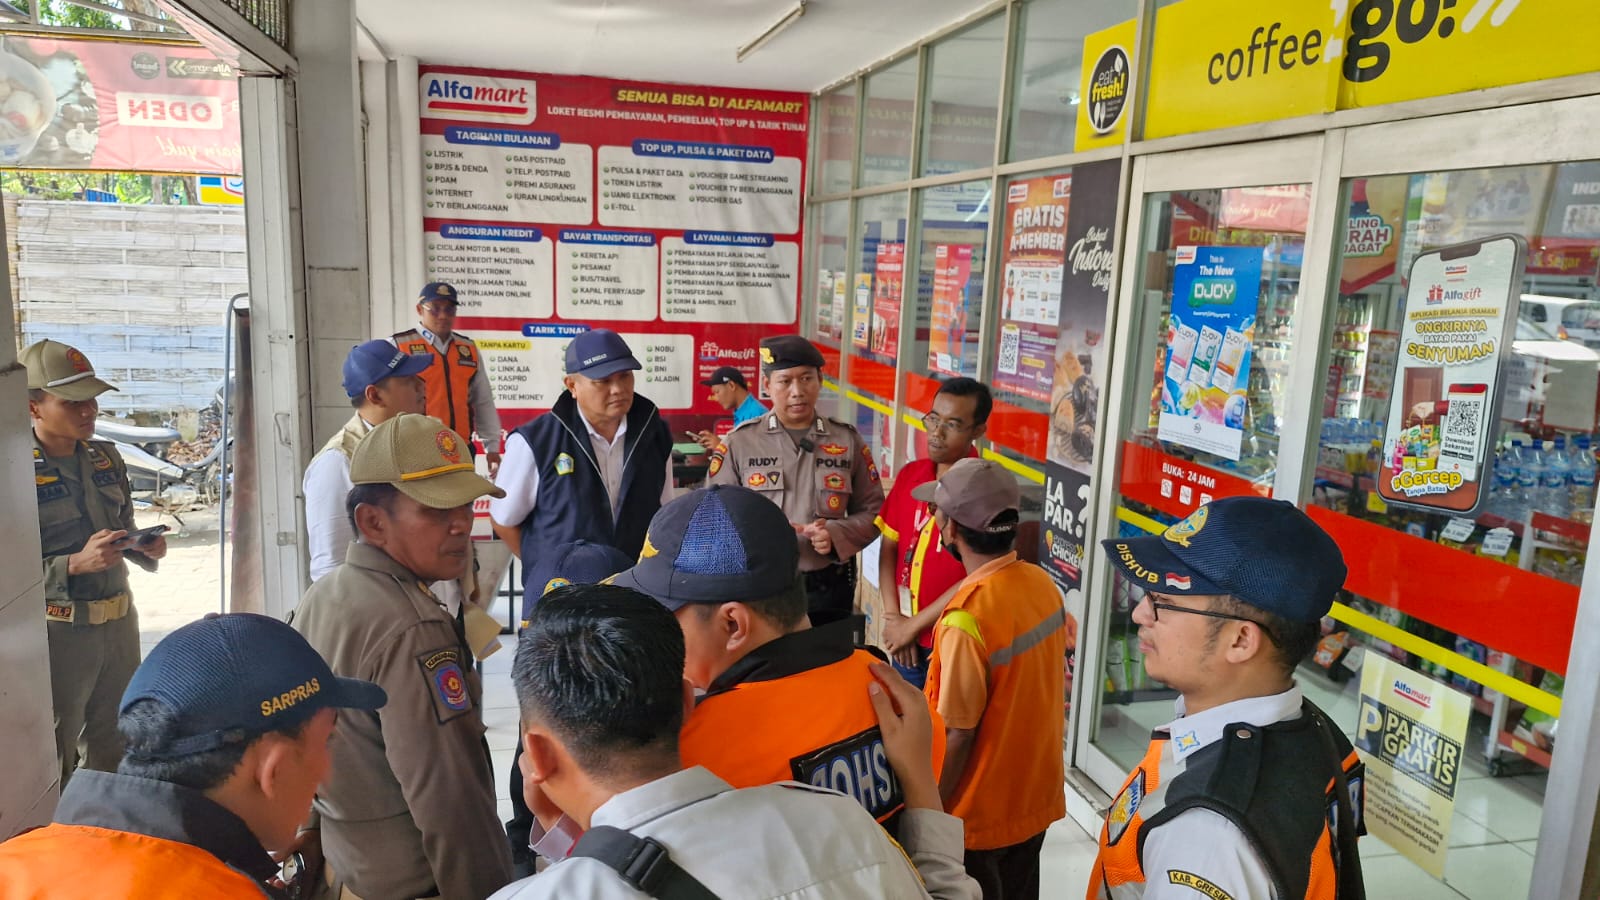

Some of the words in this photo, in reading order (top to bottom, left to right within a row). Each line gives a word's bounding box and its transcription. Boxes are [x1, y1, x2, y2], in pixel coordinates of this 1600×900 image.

[1207, 22, 1321, 84] coffee
[1098, 66, 1114, 87] eat
[428, 79, 528, 103] Alfamart
[1092, 72, 1124, 102] fresh!
[617, 90, 668, 104] SEMUA
[672, 94, 705, 107] BISA
[709, 96, 724, 107] DI
[727, 98, 802, 113] ALFAMART
[547, 106, 577, 118] LOKET
[577, 108, 606, 120] RESMI
[606, 110, 666, 123] PEMBAYARAN,
[667, 114, 718, 126] PEMBELIAN,
[720, 118, 735, 126] TOP
[736, 119, 748, 127] UP
[757, 121, 780, 130] TARIK
[782, 122, 805, 131] TUNAI
[456, 130, 502, 143] TAGIHAN
[504, 134, 551, 145] BULANAN
[434, 150, 464, 159] LISTRIK
[641, 143, 659, 152] TOP
[660, 144, 676, 155] UP,
[677, 144, 705, 155] PULSA
[716, 147, 744, 158] PAKET
[746, 149, 771, 159] DATA
[530, 156, 565, 165] POSTPAID
[434, 163, 453, 172] BPJS
[462, 165, 488, 173] DENDA
[514, 168, 532, 176] TELP.
[536, 169, 570, 177] POSTPAID
[642, 168, 664, 176] PAKET
[666, 169, 683, 177] DATA
[435, 176, 457, 184] PDAM
[697, 171, 728, 180] VOUCHER
[730, 173, 748, 181] GAME
[750, 174, 788, 183] STREAMING
[514, 181, 537, 189] PREMI
[539, 182, 575, 190] ASURANSI
[611, 179, 634, 187] TOKEN
[636, 180, 662, 188] LISTRIK
[435, 189, 473, 197] INTERNET
[697, 184, 727, 192] VOUCHER
[740, 186, 793, 195] BERLANGGANAN
[514, 193, 537, 201] IURAN
[539, 194, 587, 203] LINGKUNGAN
[632, 193, 676, 201] ELEKTRONIK
[697, 196, 727, 204] VOUCHER
[446, 202, 508, 212] BERLANGGANAN
[611, 203, 635, 211] E-TOLL
[1014, 205, 1065, 228] GRATIS
[448, 226, 500, 236] ANGSURAN
[502, 229, 533, 238] KREDIT
[563, 232, 591, 242] BAYAR
[592, 233, 652, 244] TRANSPORTASI
[692, 234, 731, 243] LAYANAN
[733, 235, 767, 245] LAINNYA
[466, 245, 491, 253] MOTOR
[500, 246, 522, 254] MOBIL
[437, 255, 465, 263] CICILAN
[494, 257, 535, 265] MULTIGUNA
[437, 266, 465, 274] CICILAN
[467, 267, 511, 275] ELEKTRONIK
[580, 263, 611, 271] PESAWAT
[1200, 266, 1214, 276] The
[1215, 266, 1234, 276] New
[580, 275, 622, 283] BUS/TRAVEL
[604, 288, 645, 296] FERRY/ASDP
[1194, 283, 1234, 300] DJOY
[1444, 288, 1482, 302] Alfagift
[529, 325, 554, 335] TARIK
[1416, 320, 1487, 334] ONGKIRNYA
[480, 340, 503, 350] TANPA
[504, 341, 526, 350] KARTU
[655, 344, 675, 354] NOBU
[718, 347, 756, 360] Alfagift
[1407, 342, 1494, 362] SENYUMAN
[497, 355, 518, 364] DANA
[655, 355, 667, 363] BSI
[497, 365, 515, 374] LINK
[516, 365, 530, 374] AJA
[655, 365, 667, 374] BNI
[497, 374, 527, 383] KASPRO
[655, 375, 680, 384] ALADIN
[497, 384, 518, 392] DOKU
[497, 393, 515, 402] TRUE
[517, 394, 544, 402] MONEY
[748, 456, 778, 468] RUDY
[1162, 462, 1184, 479] BUKA:
[1188, 470, 1196, 482] 24
[1198, 472, 1215, 489] JAM
[1394, 471, 1462, 488] #Gercep
[1046, 476, 1064, 507] LA
[1044, 499, 1073, 535] PAR
[1116, 543, 1159, 584] DISHUB
[260, 678, 321, 716] SARPRAS
[1394, 680, 1431, 704] Alfamart
[1386, 713, 1457, 768] PARKIR
[1384, 733, 1454, 785] GRATIS
[1172, 872, 1193, 885] KAB.
